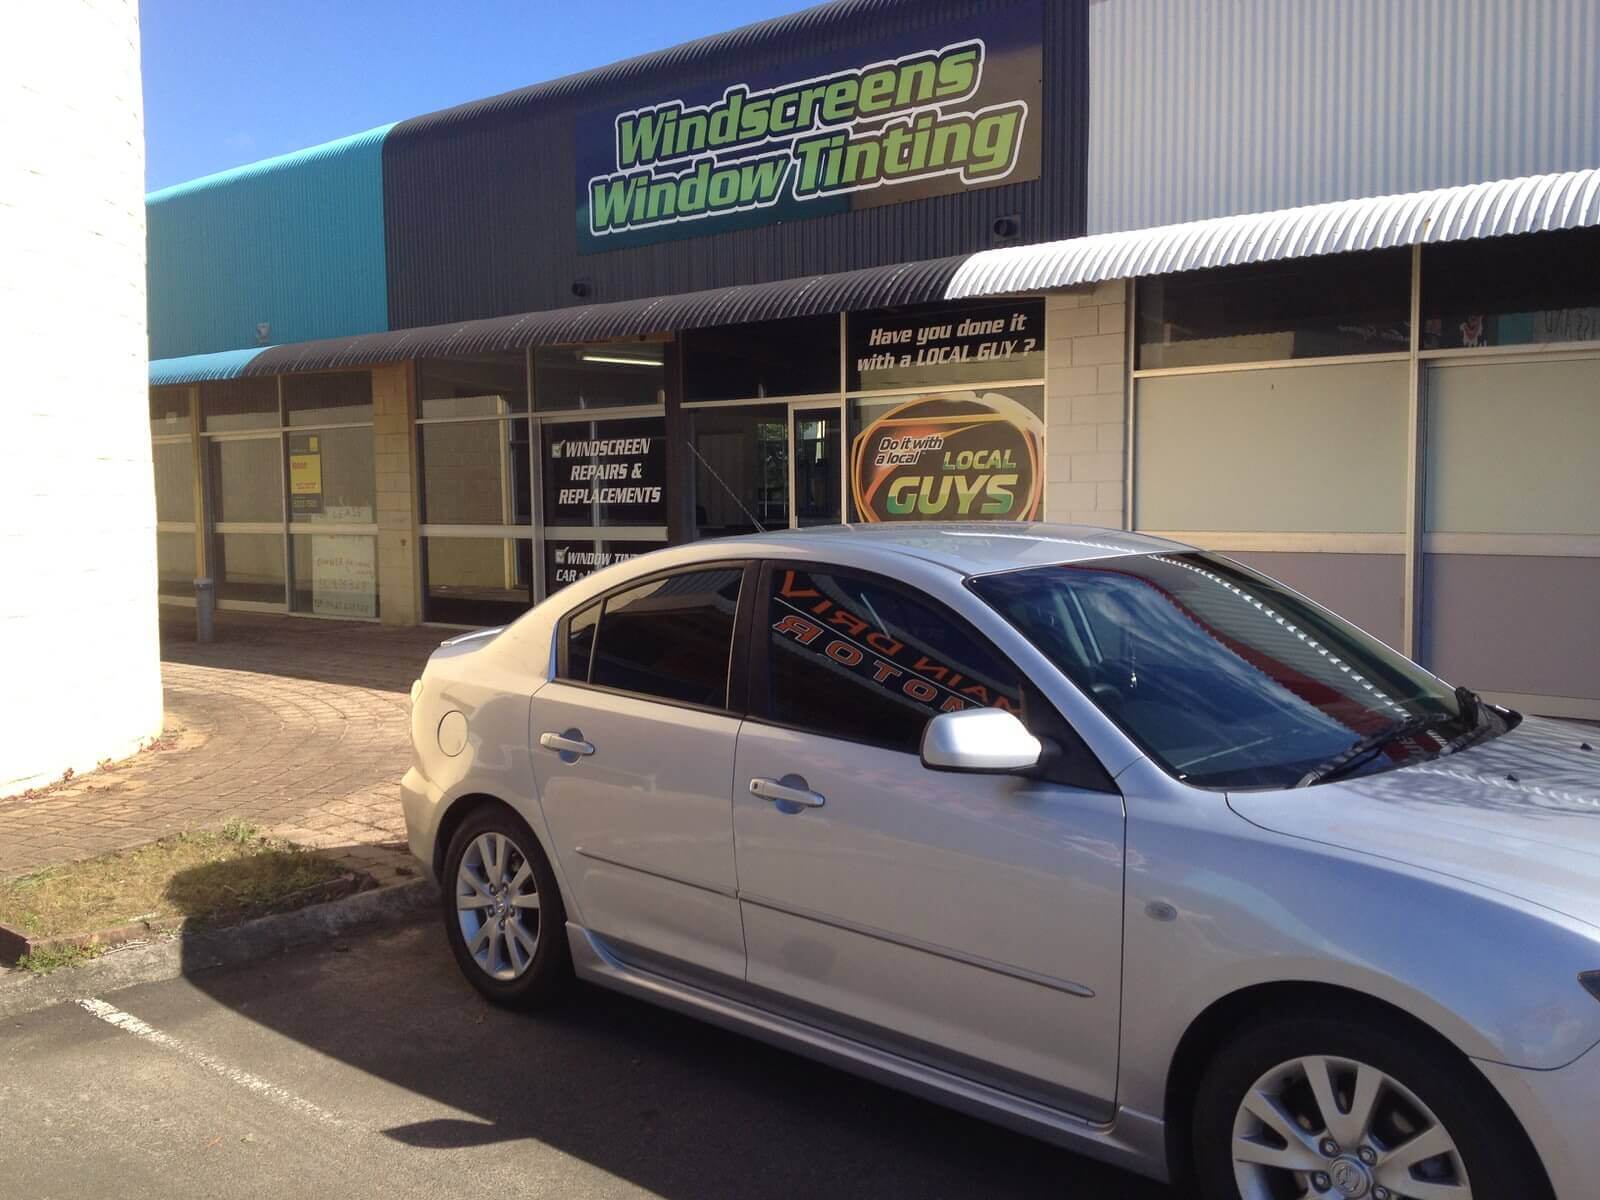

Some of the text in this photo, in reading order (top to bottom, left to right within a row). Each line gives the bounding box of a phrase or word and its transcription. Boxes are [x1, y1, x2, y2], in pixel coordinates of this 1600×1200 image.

[618, 44, 981, 168] Windscreens
[591, 105, 1022, 230] Window Tinting
[870, 313, 1027, 346] Have you done it
[857, 353, 894, 371] with
[900, 353, 910, 368] a
[917, 345, 969, 367] LOCAL
[978, 340, 1017, 360] GUY
[566, 438, 650, 457] WINDSCREEN
[879, 435, 943, 451] Do it with
[876, 451, 919, 465] a local
[944, 449, 1016, 470] LOCAL
[571, 463, 642, 480] REPAIRS &
[559, 487, 661, 504] REPLACEMENTS
[886, 475, 1018, 514] GUYS
[568, 552, 612, 566] WINDOW
[556, 569, 577, 582] CAR
